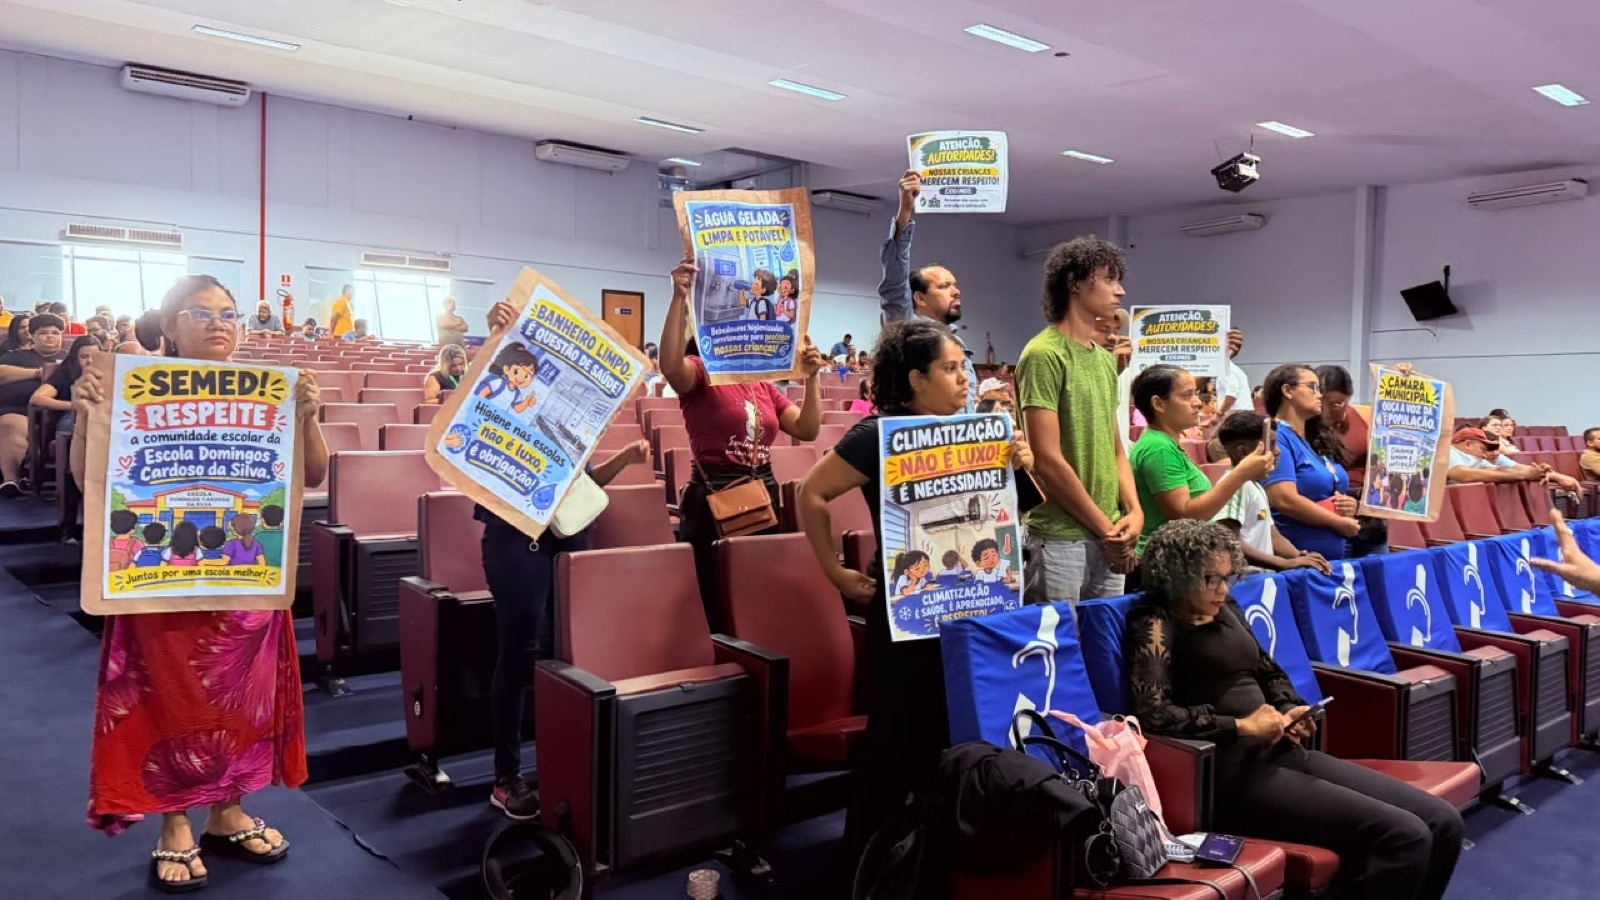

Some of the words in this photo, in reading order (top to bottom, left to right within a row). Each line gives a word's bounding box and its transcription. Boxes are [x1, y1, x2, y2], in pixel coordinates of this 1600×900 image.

[940, 138, 983, 151] ATENÇÃO,
[927, 149, 995, 164] AUTORIDADES!
[920, 177, 960, 186] MERECEM
[961, 177, 1000, 186] RESPEITO!
[929, 168, 956, 176] NOSSAS
[957, 168, 991, 177] CRIANÇAS
[704, 209, 736, 227] ÁGUA
[738, 210, 784, 227] GELADA,
[701, 230, 734, 245] LIMPA
[736, 231, 741, 240] E
[744, 226, 786, 244] POTÁVEL!
[1159, 311, 1204, 323] ATENÇÃO,
[1146, 320, 1217, 335] AUTORIDADES!
[536, 304, 597, 350] BANHEIRO
[596, 341, 631, 375] LIMPO
[1147, 337, 1176, 345] NOSSAS
[525, 322, 534, 336] É
[535, 328, 578, 362] QUESTÃO
[580, 355, 590, 369] DE
[590, 362, 623, 396] SAÚDE!
[714, 344, 742, 356] nossas
[1139, 346, 1179, 354] MERECEM
[149, 370, 270, 397] SEMED!
[1388, 375, 1425, 391] CÂMARA
[145, 401, 268, 428] RESPEITE
[1382, 401, 1400, 413] OUÇA
[1400, 403, 1405, 412] A
[1405, 404, 1422, 414] VOZ
[1423, 406, 1433, 416] DA
[130, 436, 139, 445] a
[143, 431, 217, 445] comunidade
[221, 431, 262, 443] escolar
[267, 432, 280, 445] da
[474, 400, 511, 431] Higiene
[512, 424, 532, 442] nas
[533, 438, 566, 467] escolas
[893, 418, 1005, 452] CLIMATIZAÇÃO
[144, 446, 194, 464] Escola
[199, 446, 271, 466] Domingos
[480, 425, 504, 445] não
[505, 437, 514, 450] é
[515, 442, 543, 474] luxo,
[468, 441, 477, 457] é
[479, 449, 536, 489] obrigação!
[899, 451, 939, 477] NÃO
[944, 445, 952, 469] É
[956, 443, 1001, 467] LUXO!
[140, 463, 204, 481] Cardoso
[208, 463, 226, 479] da
[230, 462, 271, 480] Silva.
[900, 482, 910, 502] É
[914, 469, 1004, 500] NECESSIDADE!
[125, 571, 159, 584] Juntos
[162, 569, 179, 580] por
[204, 568, 230, 576] escola
[233, 567, 268, 578] melhor!
[922, 584, 990, 606] CLIMATIZAÇÃO
[914, 607, 920, 619] É
[948, 601, 955, 612] É
